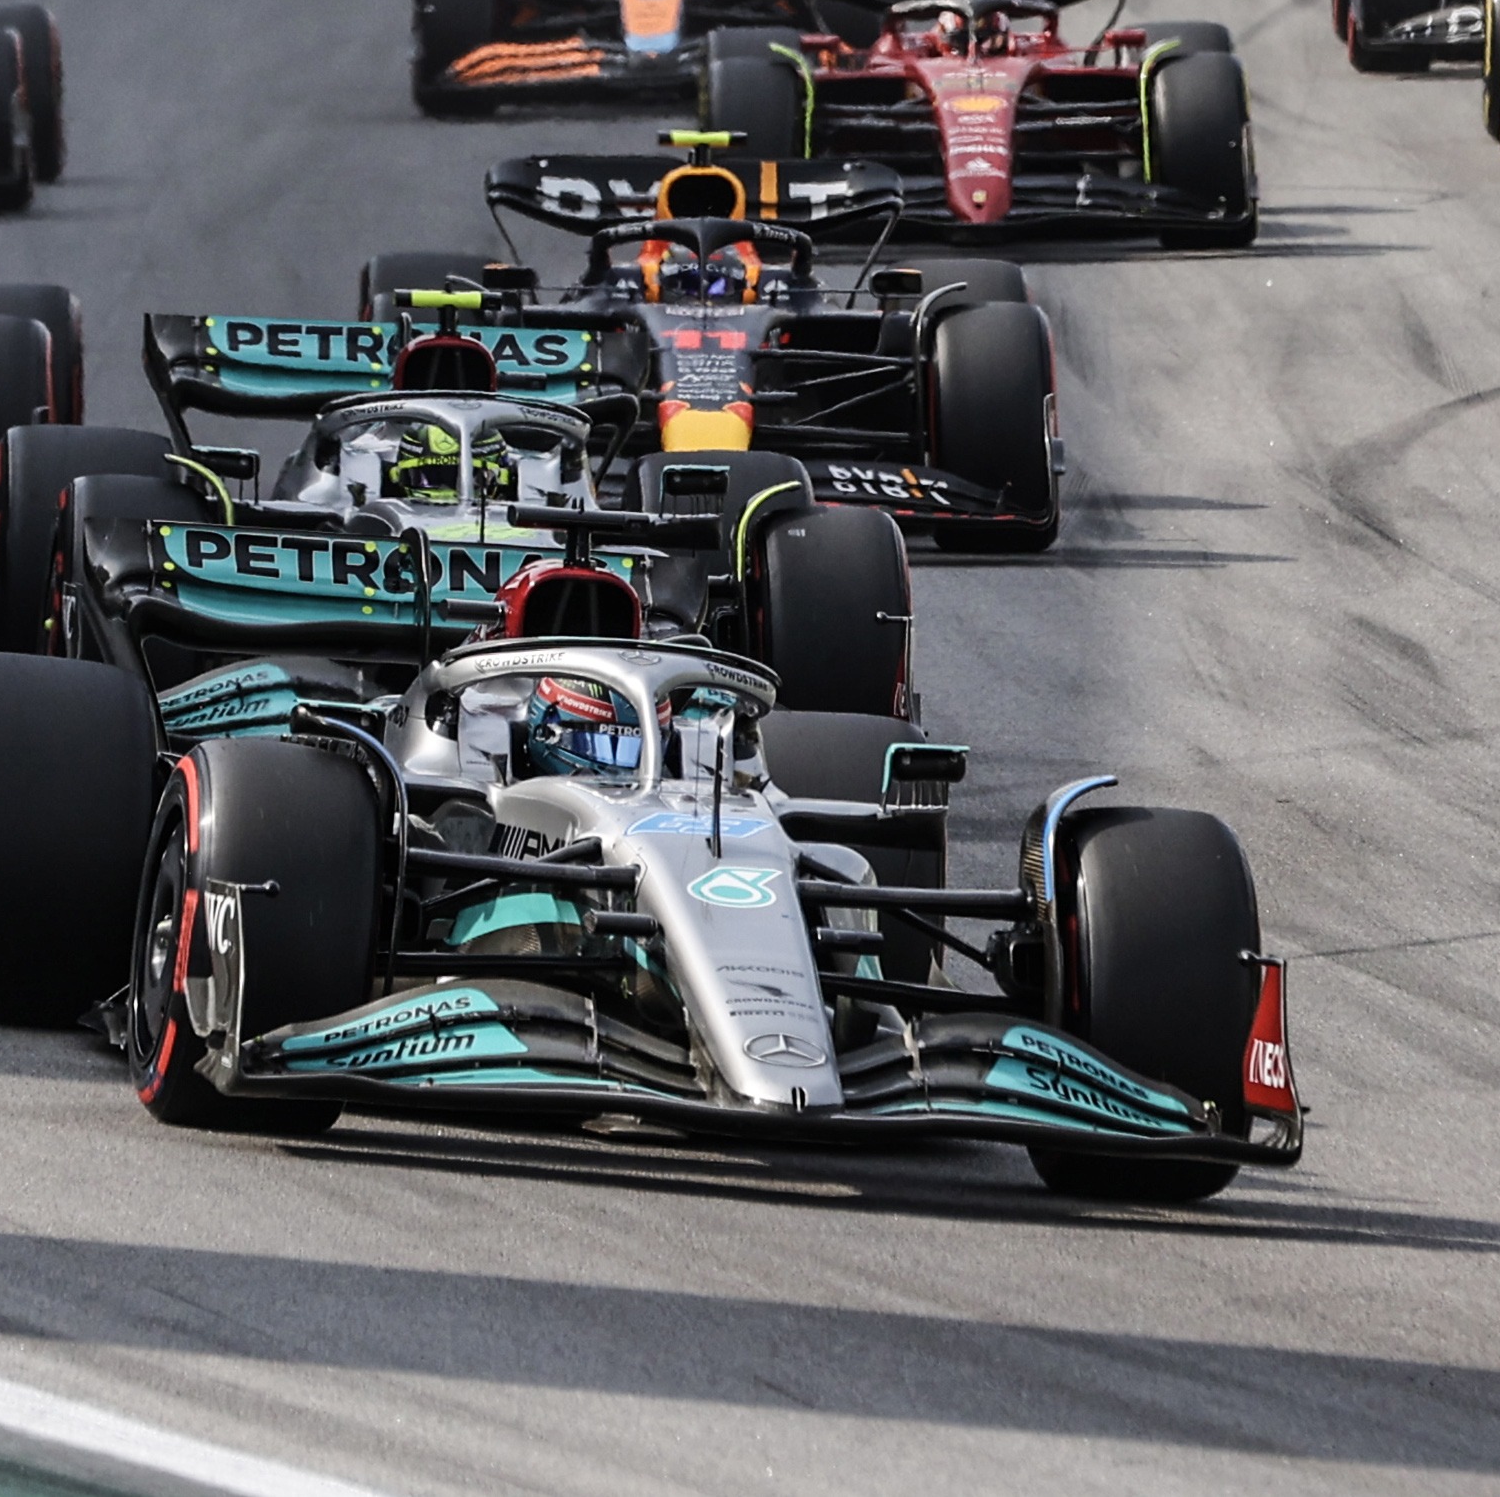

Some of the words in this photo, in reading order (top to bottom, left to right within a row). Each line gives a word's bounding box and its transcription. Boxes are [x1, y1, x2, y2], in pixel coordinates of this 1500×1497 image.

[599, 723, 642, 739] PETRO
[324, 997, 471, 1044] PETRONAS
[1021, 1034, 1150, 1101] PETRONAS
